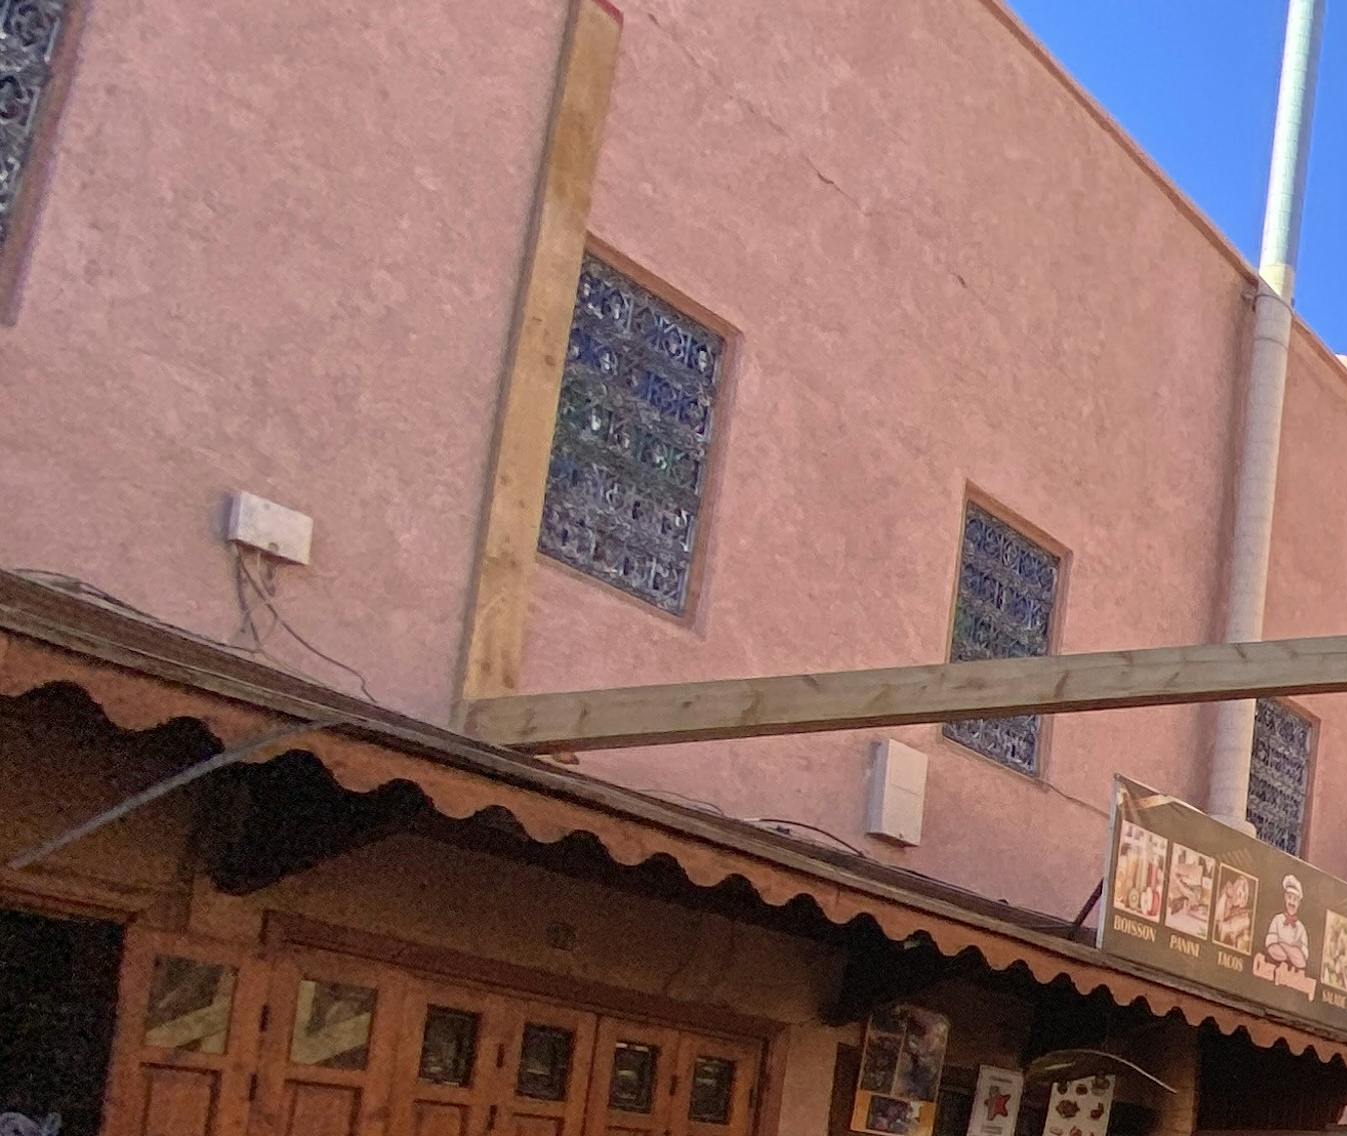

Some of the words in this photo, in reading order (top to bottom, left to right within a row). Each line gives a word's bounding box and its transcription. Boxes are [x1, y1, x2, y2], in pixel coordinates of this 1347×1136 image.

[1113, 915, 1157, 942] BOISSON
[1169, 934, 1200, 957] PANINI
[1218, 951, 1243, 972] TACOS
